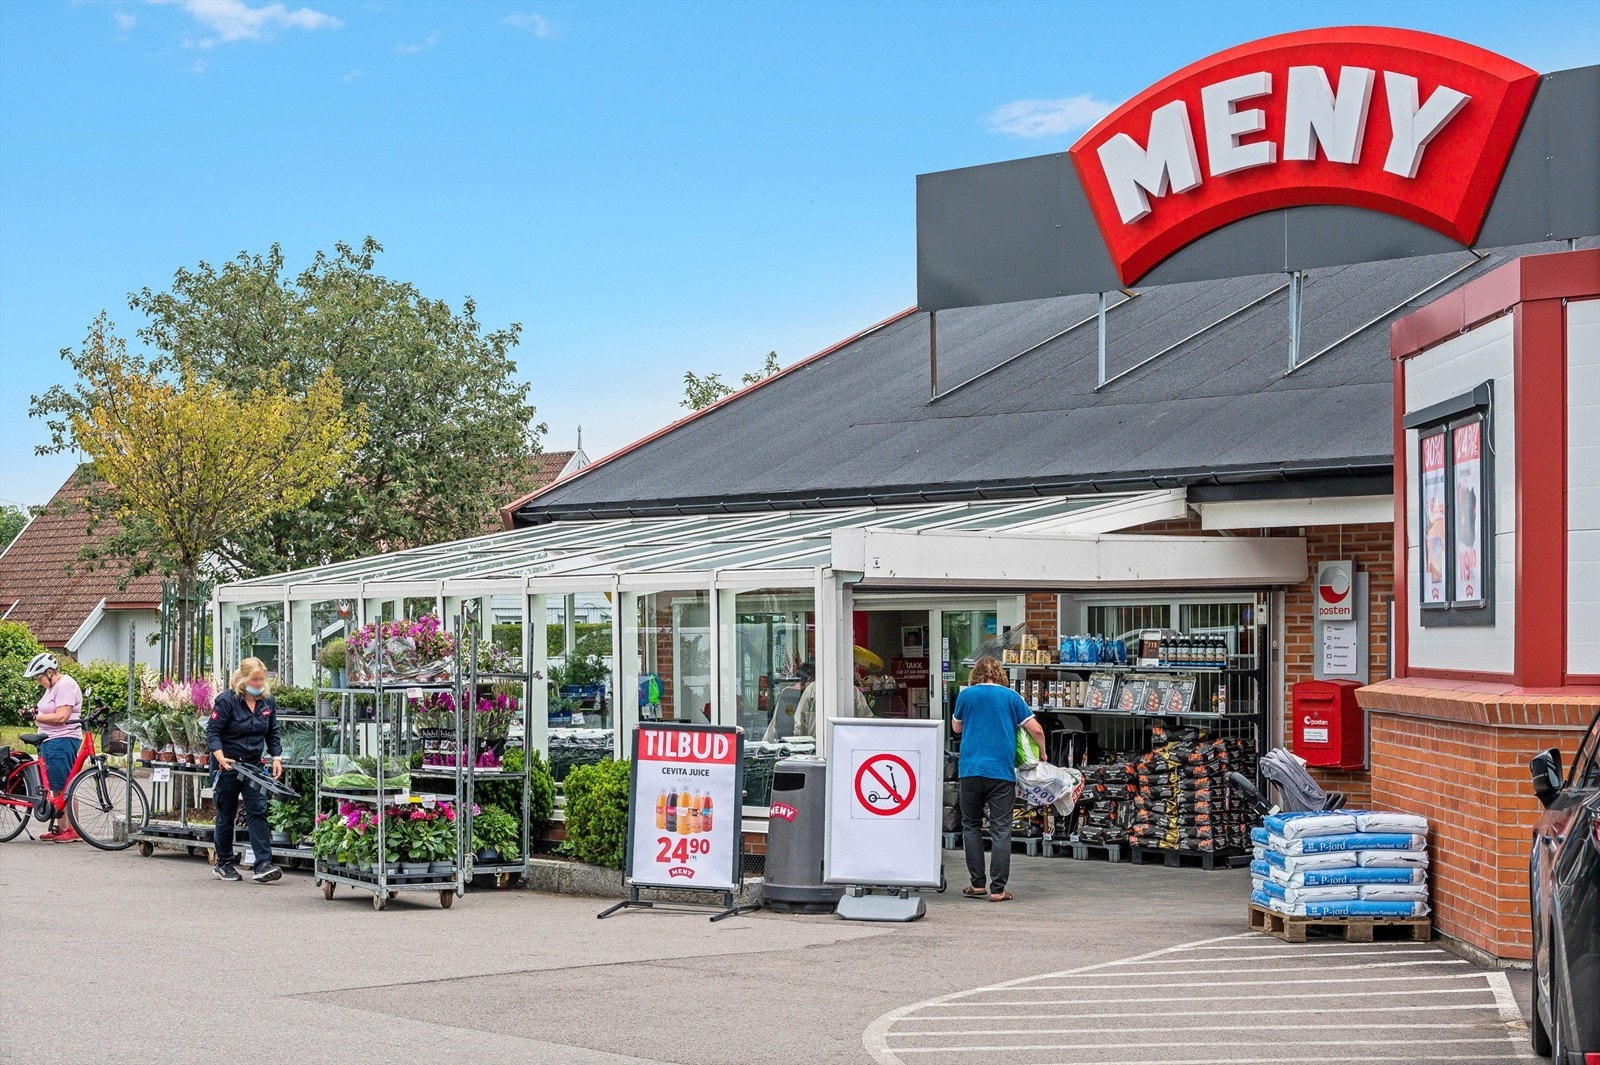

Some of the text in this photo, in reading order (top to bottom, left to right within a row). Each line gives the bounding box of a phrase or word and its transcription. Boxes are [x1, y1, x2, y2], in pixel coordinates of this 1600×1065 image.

[1096, 65, 1472, 225] MENY
[1319, 605, 1351, 617] posten
[1310, 718, 1329, 726] posten
[645, 730, 729, 759] TILBUD
[661, 766, 710, 777] CEVITA JUICE
[770, 805, 794, 818] MENY
[1320, 841, 1346, 852] P-jord
[671, 867, 693, 876] MENY
[1321, 875, 1347, 885] P-jord
[1323, 906, 1349, 916] P-jord
